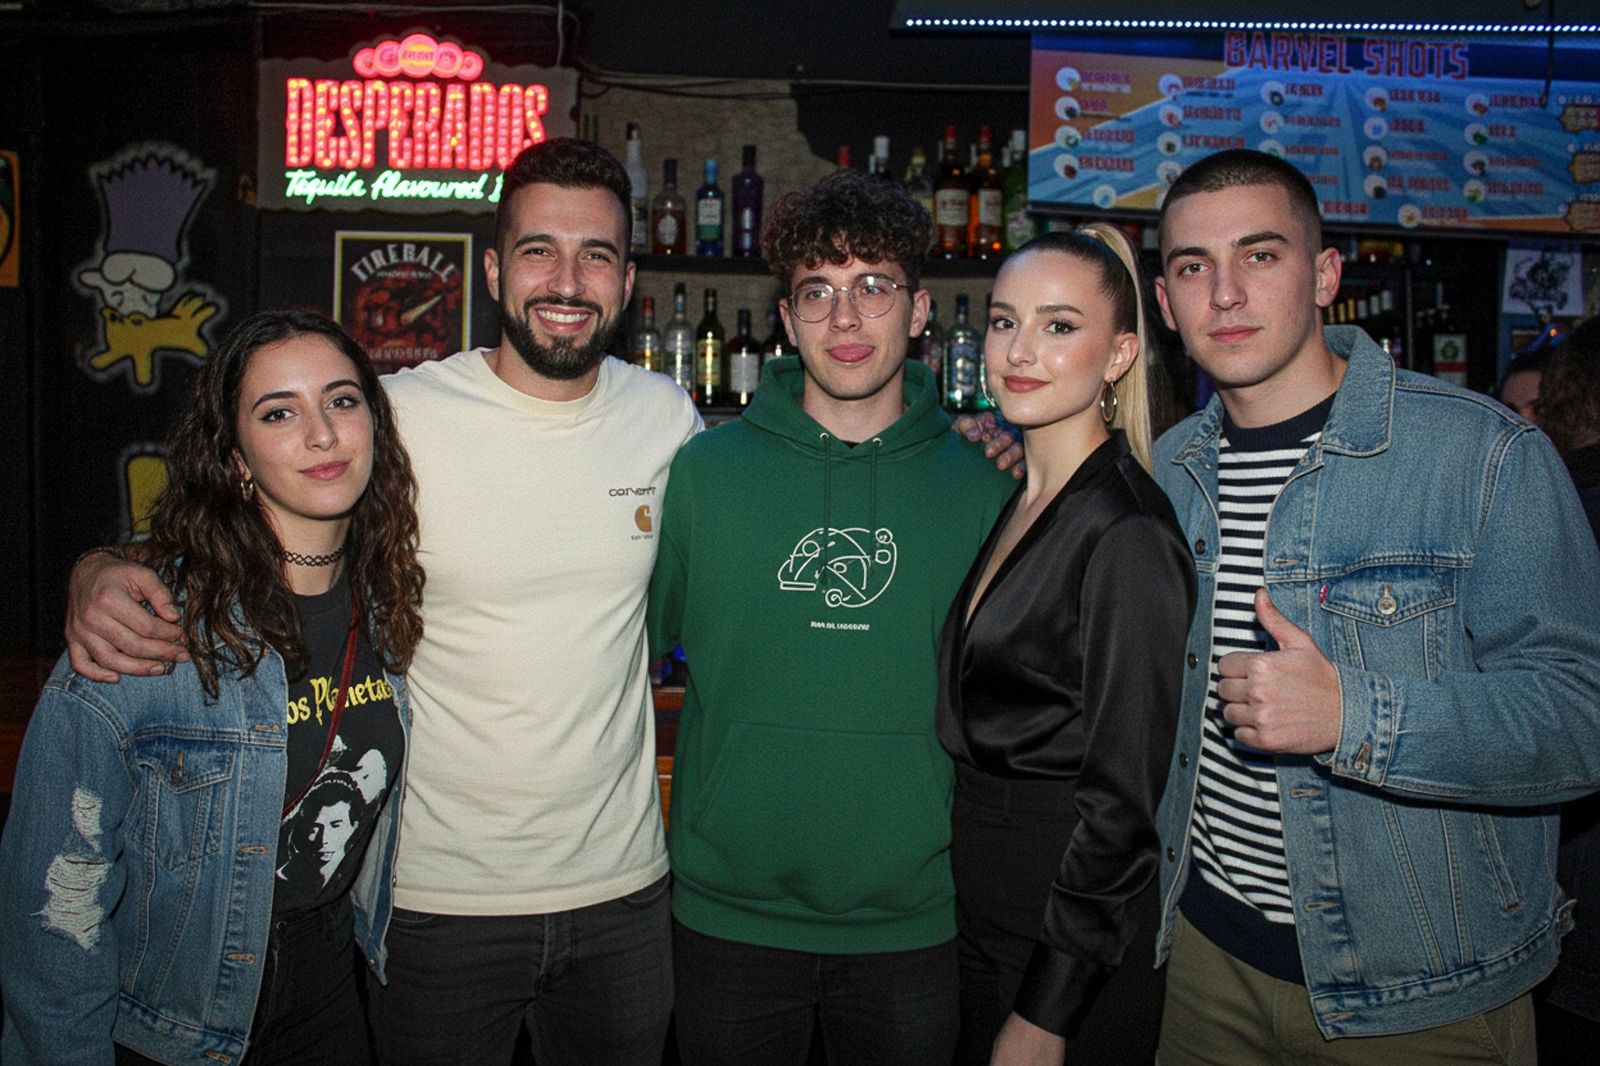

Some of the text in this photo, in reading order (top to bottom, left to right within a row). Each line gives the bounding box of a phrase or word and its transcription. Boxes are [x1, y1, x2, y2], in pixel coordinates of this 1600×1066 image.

[1225, 32, 1469, 79] BARVEL SHOTS
[286, 77, 549, 170] DESPERADOS
[285, 169, 366, 204] Tequila
[351, 243, 455, 282] FIREBALL
[288, 697, 311, 725] os
